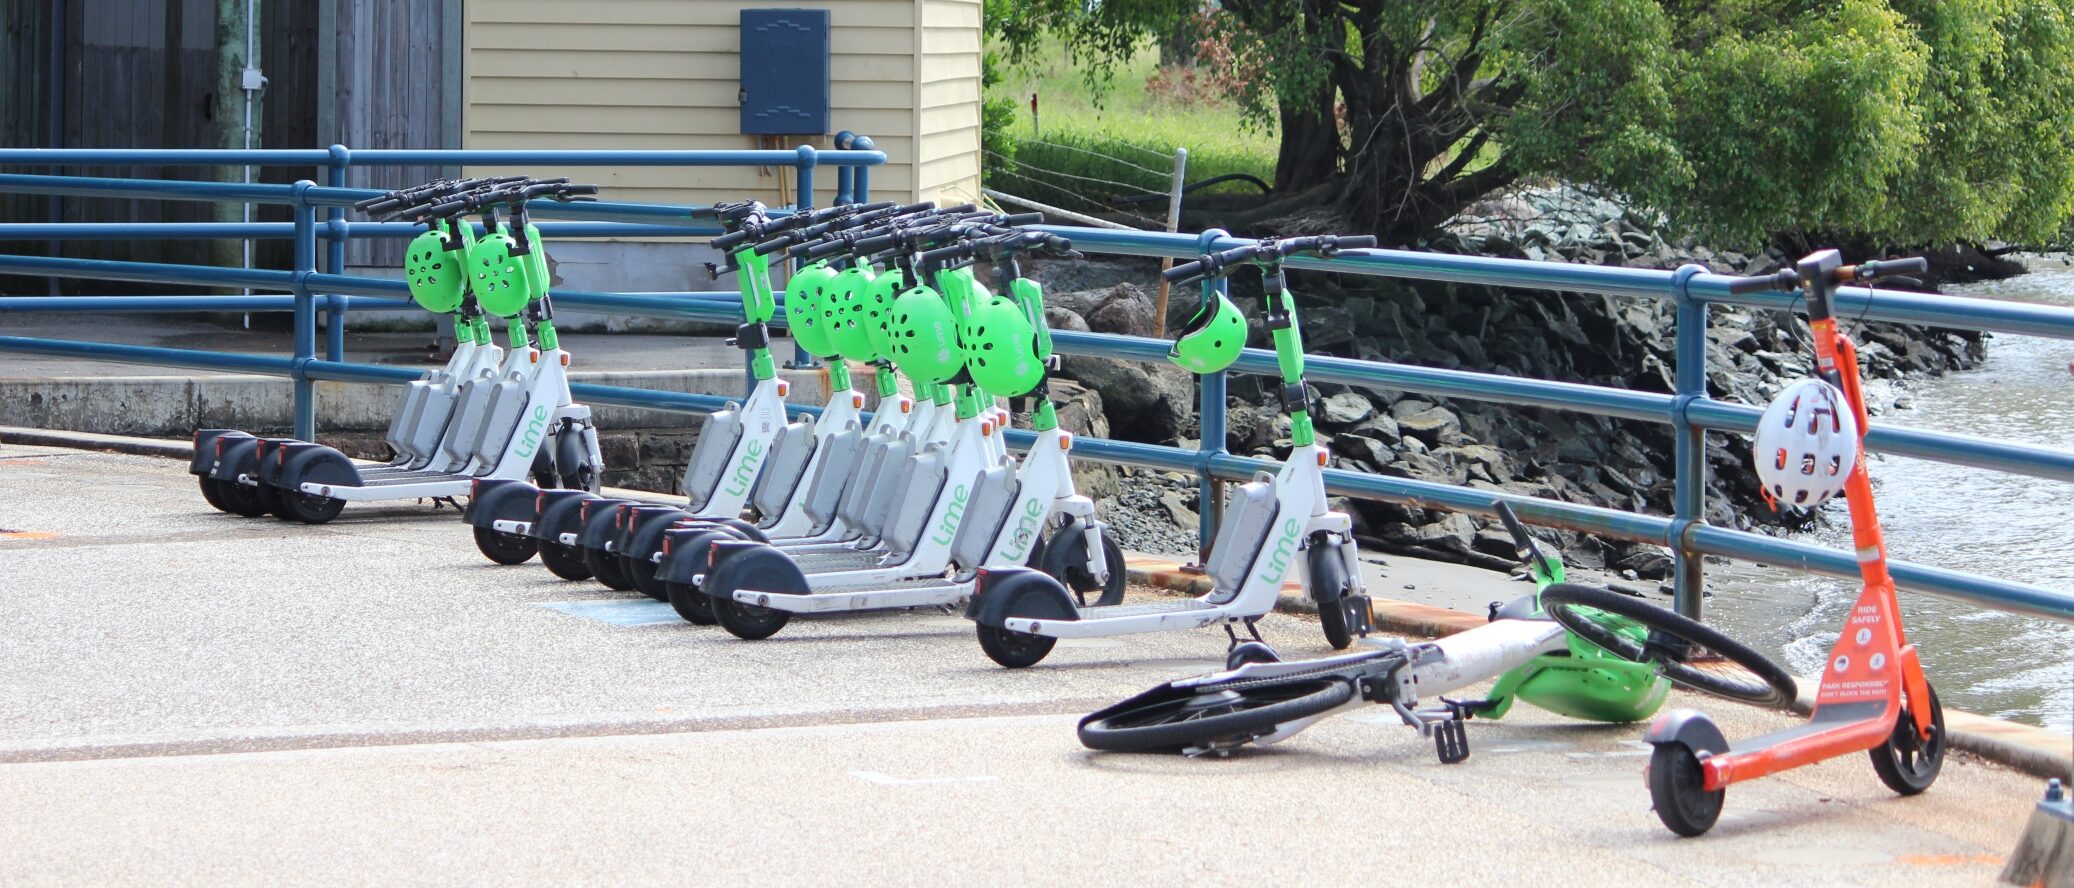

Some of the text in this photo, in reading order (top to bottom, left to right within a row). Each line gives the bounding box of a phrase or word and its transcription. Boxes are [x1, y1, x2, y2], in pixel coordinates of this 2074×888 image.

[514, 404, 548, 458] Lime
[725, 439, 763, 497] Lime
[932, 484, 969, 546] Lime
[1260, 517, 1300, 585] Lime
[1851, 615, 1881, 624] SAFELY
[1857, 605, 1878, 614] RIDE
